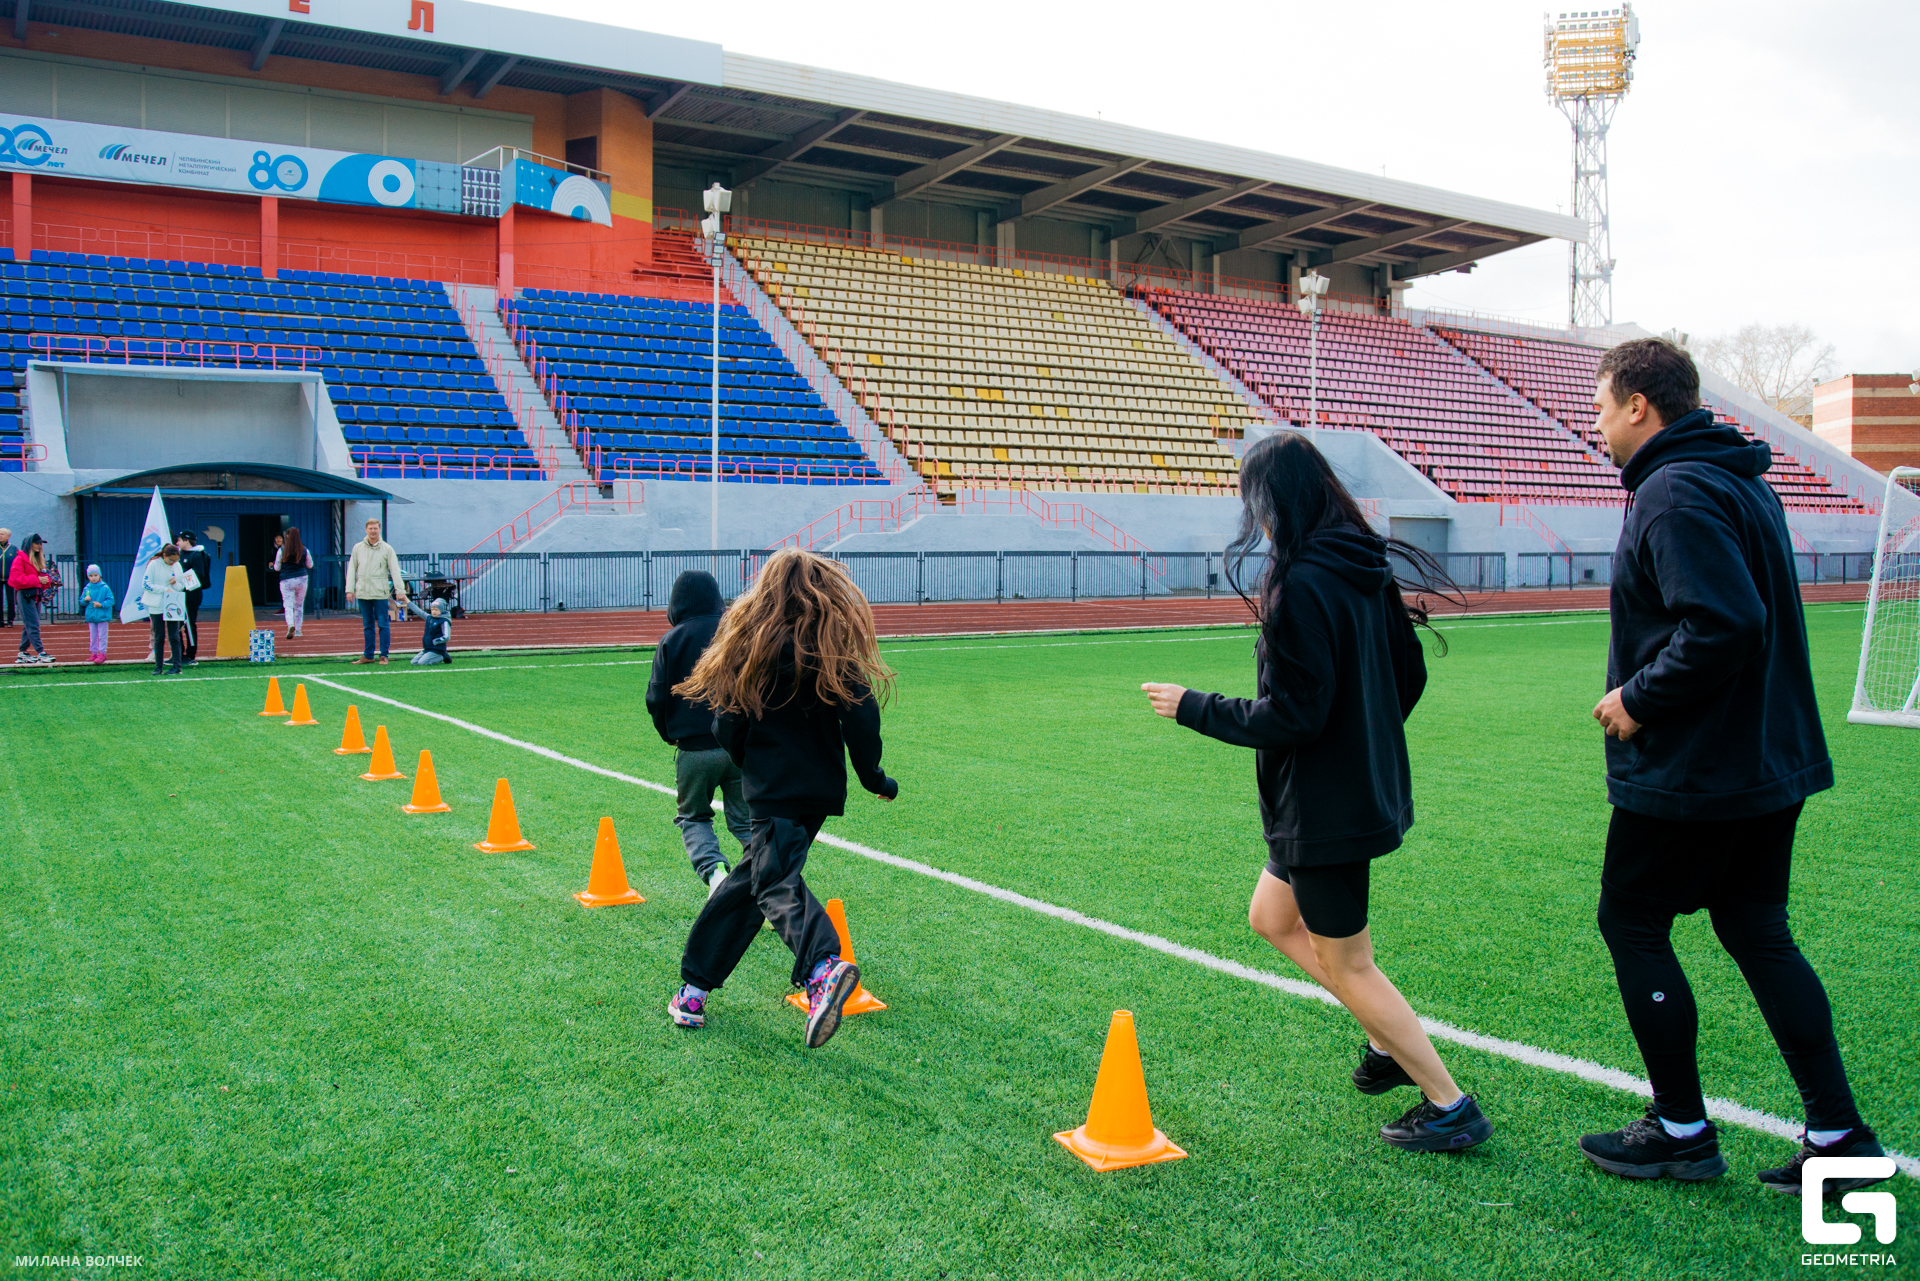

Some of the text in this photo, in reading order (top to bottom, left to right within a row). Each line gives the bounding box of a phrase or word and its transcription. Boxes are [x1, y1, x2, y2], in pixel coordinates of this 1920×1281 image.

[33, 145, 68, 155] МЕЧЕЛ
[121, 153, 167, 166] МЕЧЕЛ
[248, 150, 308, 192] 80
